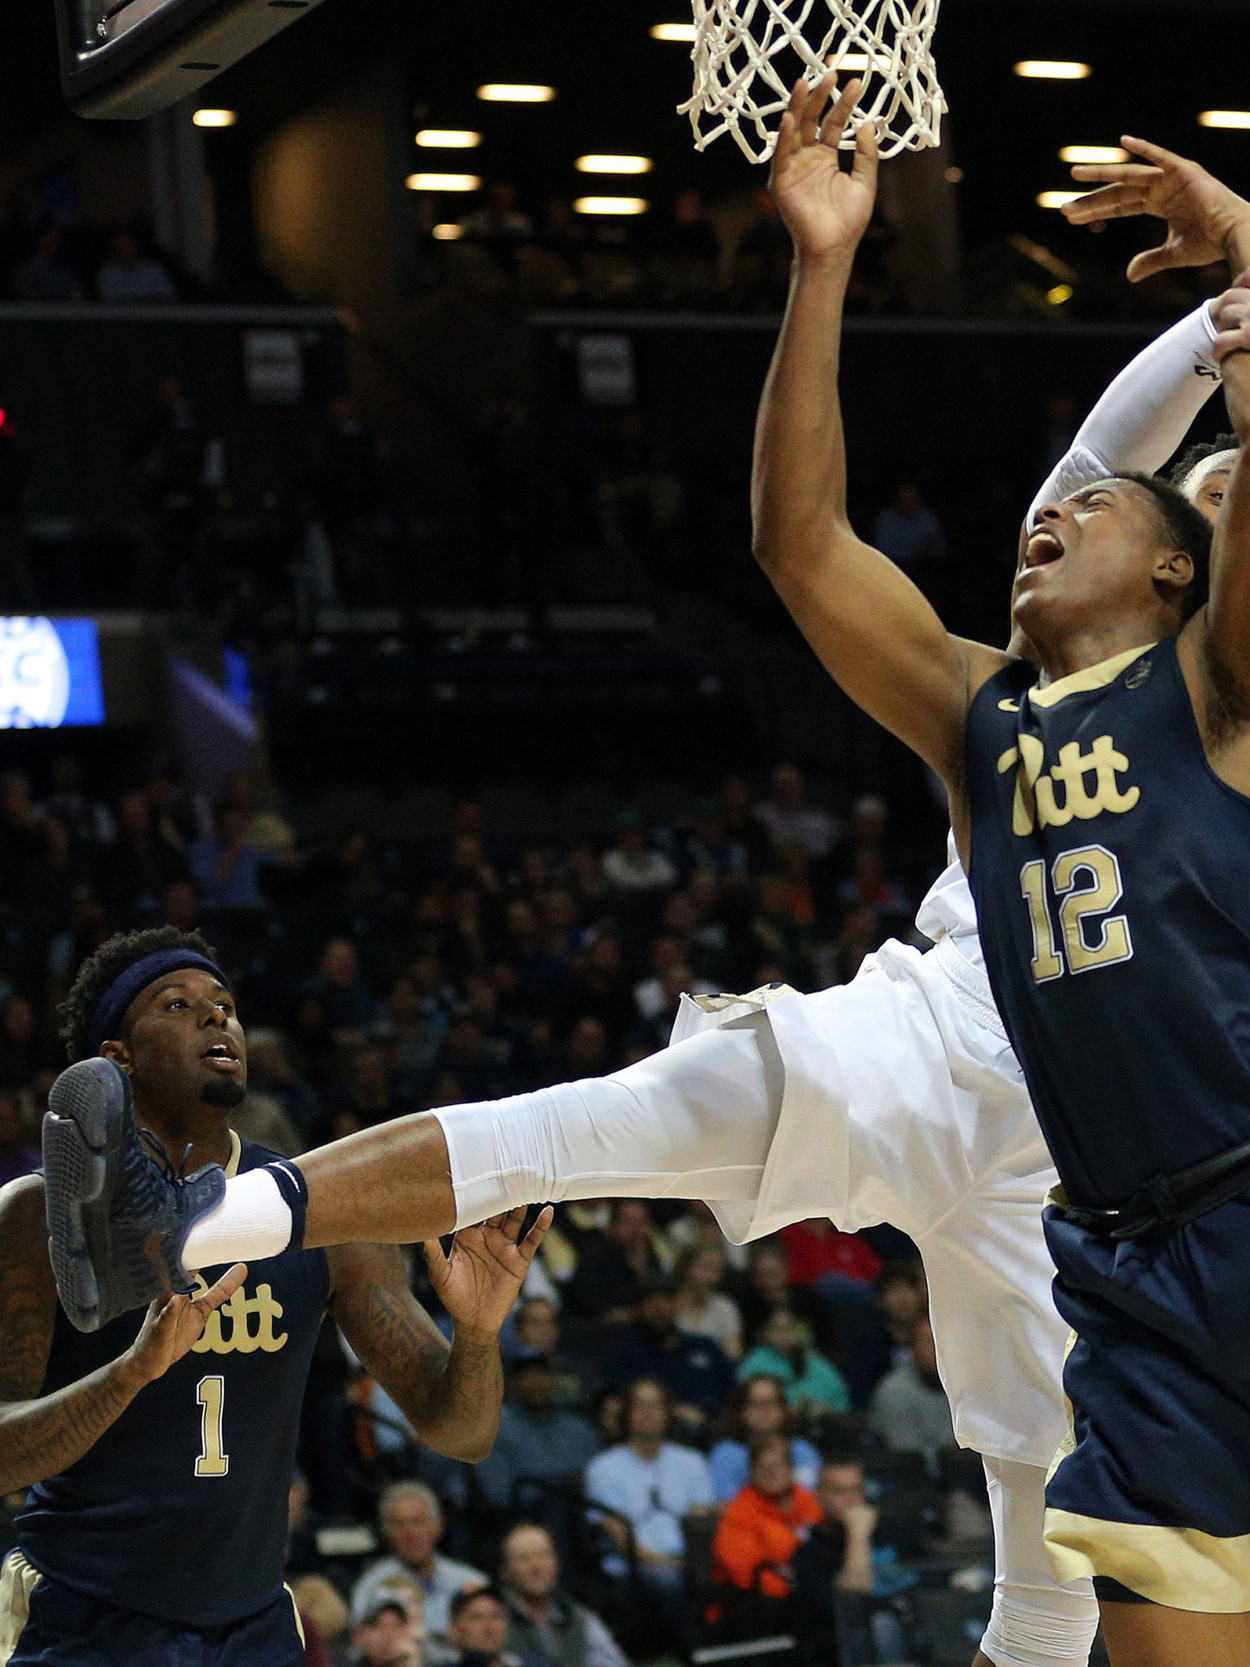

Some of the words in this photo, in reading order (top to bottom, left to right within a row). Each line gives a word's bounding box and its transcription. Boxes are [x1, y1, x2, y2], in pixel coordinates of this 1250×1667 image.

[997, 734, 1141, 837] Pitt
[1020, 843, 1134, 984] 12
[194, 1375, 229, 1477] 1
